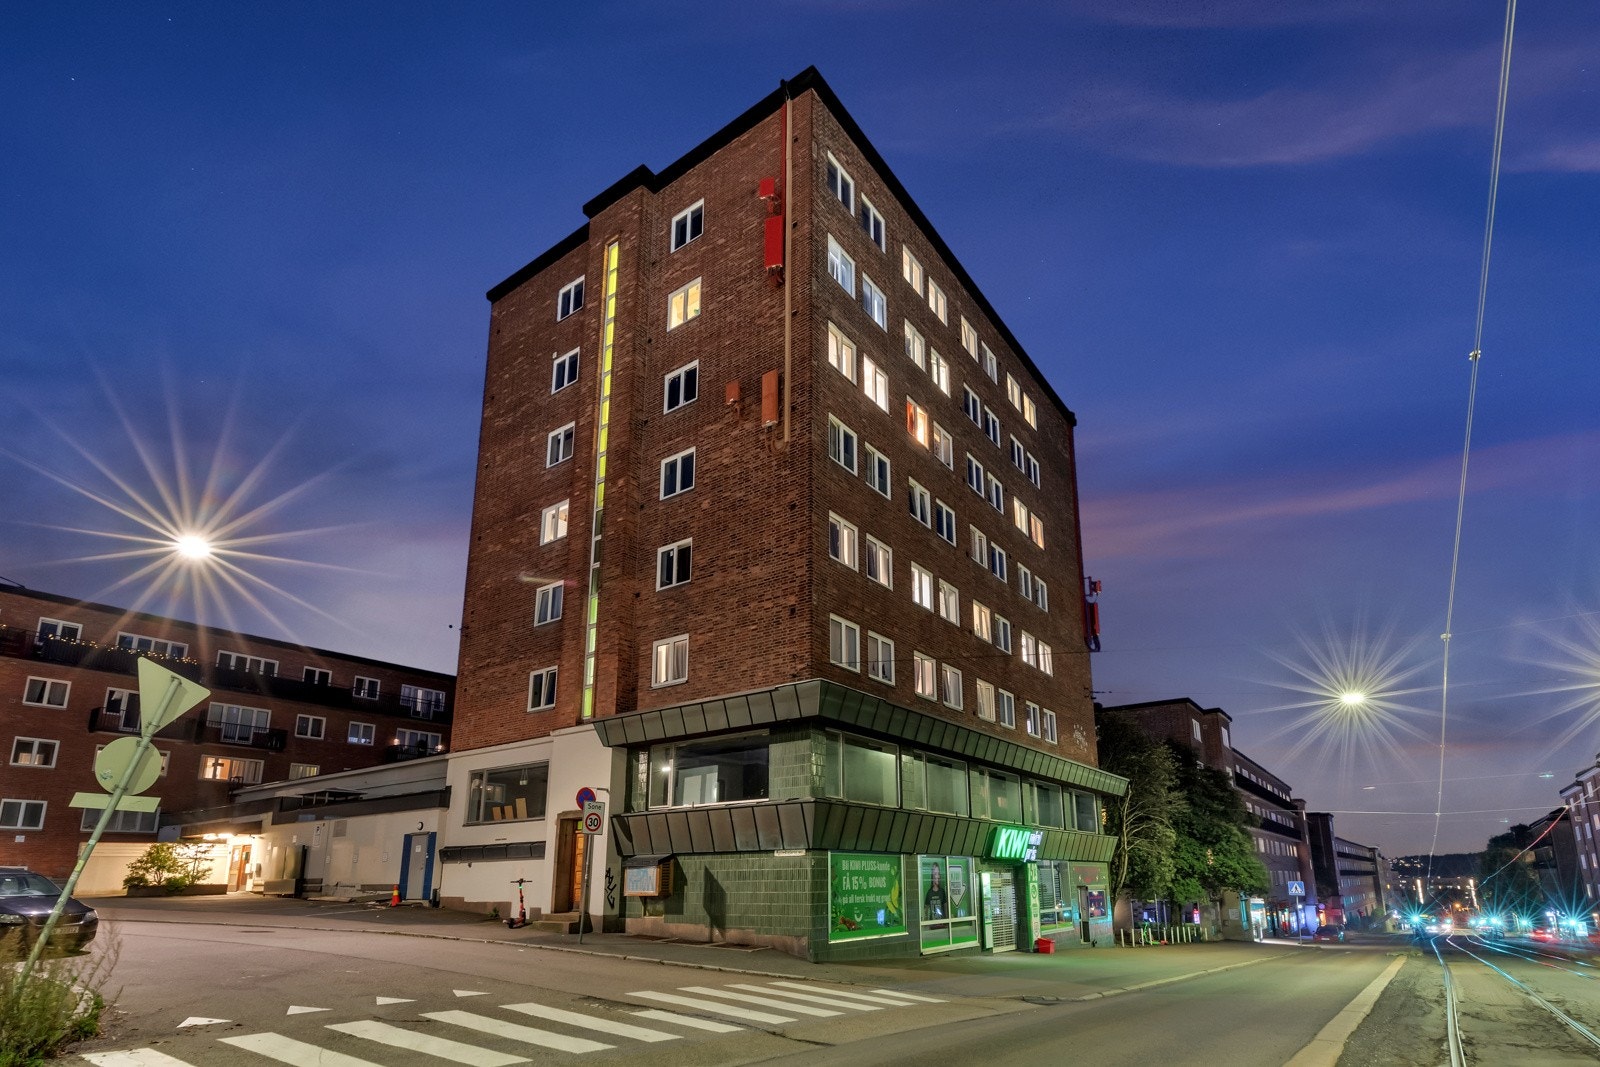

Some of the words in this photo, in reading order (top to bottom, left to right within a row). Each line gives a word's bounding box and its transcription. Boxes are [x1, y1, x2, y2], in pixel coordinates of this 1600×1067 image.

[588, 818, 599, 827] 30
[996, 828, 1030, 858] KIWI
[850, 860, 861, 870] KIWI
[842, 872, 850, 890] FÅ
[869, 876, 886, 888] BONUS
